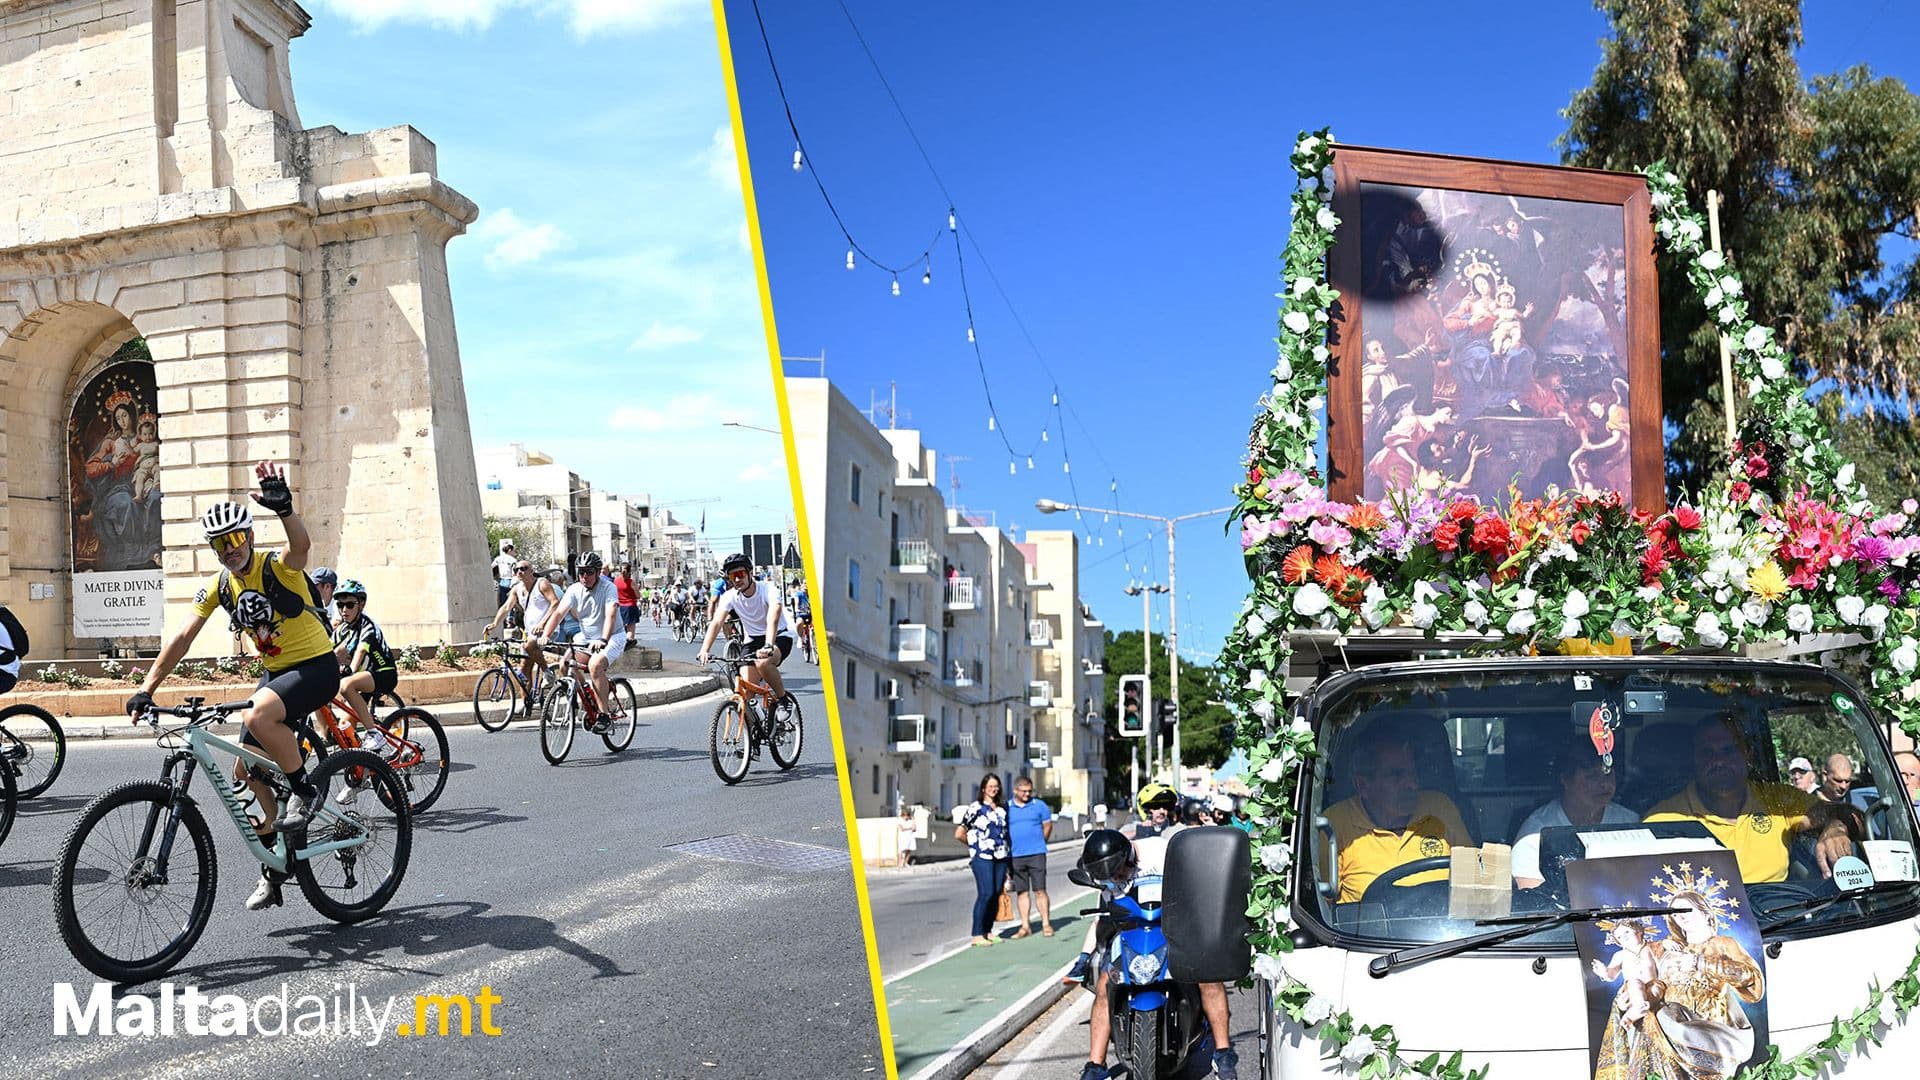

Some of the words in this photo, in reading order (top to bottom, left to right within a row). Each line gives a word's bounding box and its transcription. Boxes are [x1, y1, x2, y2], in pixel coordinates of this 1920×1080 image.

[85, 582, 121, 593] MATER
[104, 596, 146, 608] GRATIÆ
[1581, 680, 1588, 688] 3
[204, 763, 259, 842] SPECIALIZED
[1836, 868, 1869, 878] PITKALIJA
